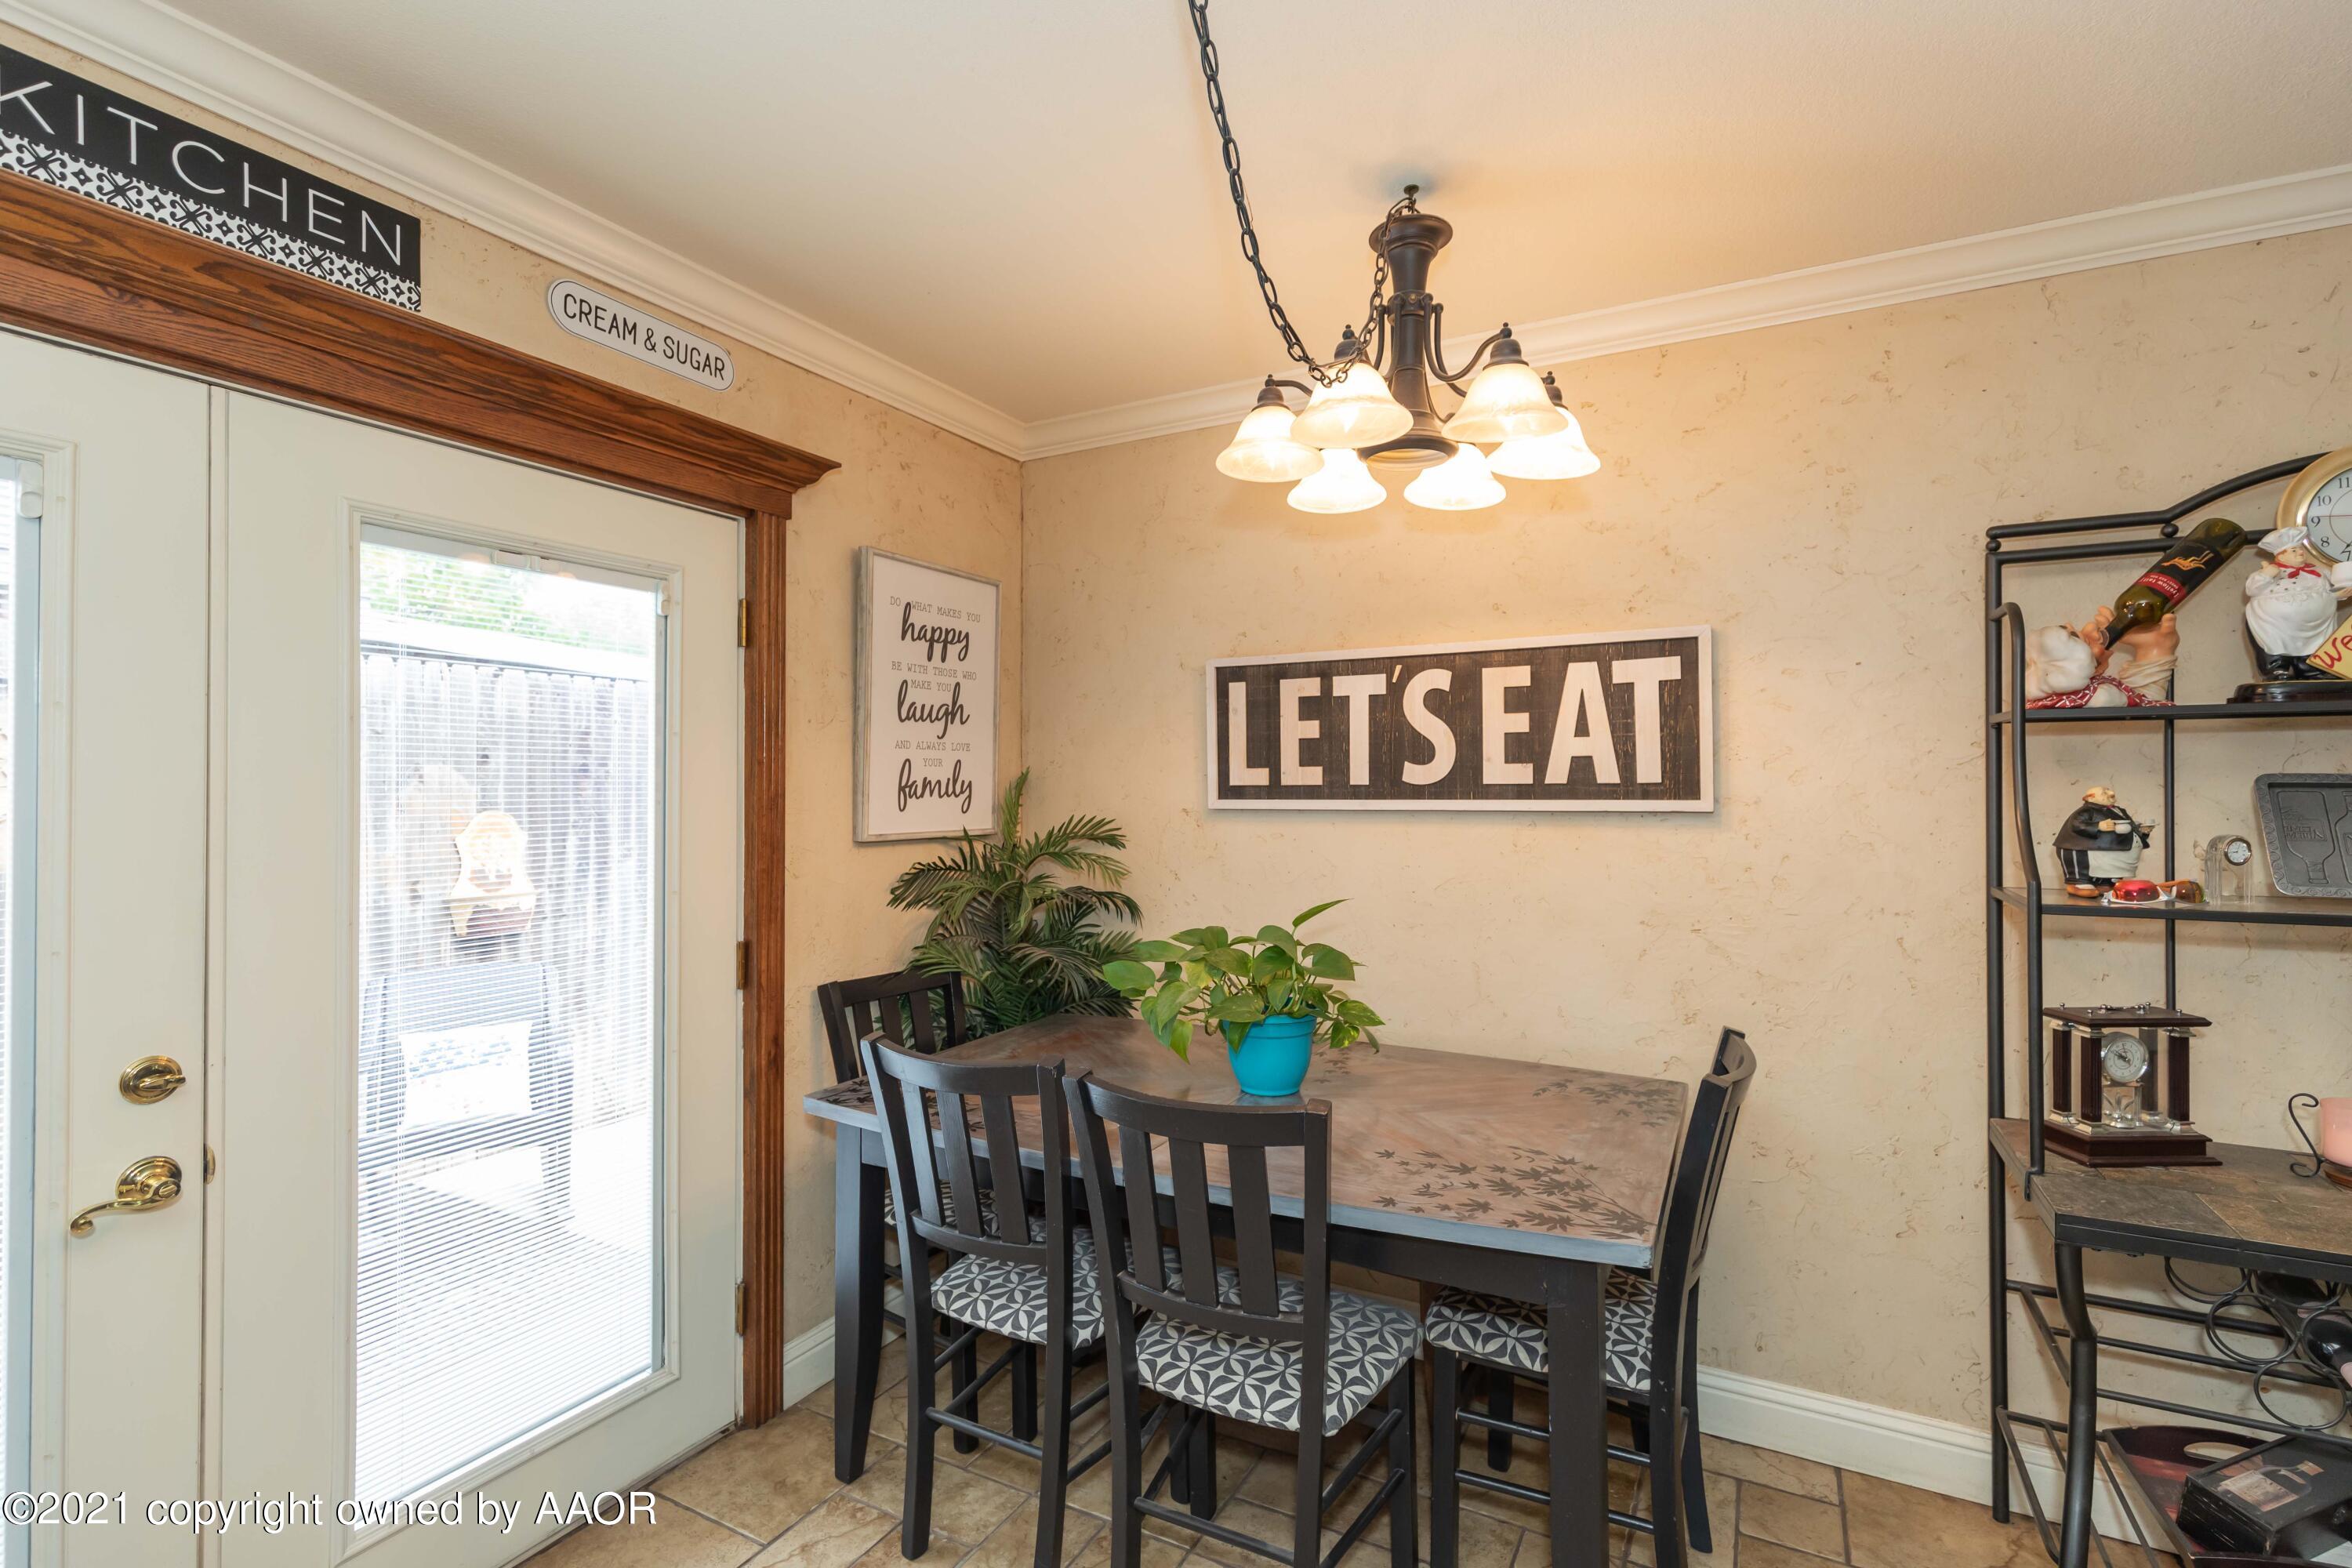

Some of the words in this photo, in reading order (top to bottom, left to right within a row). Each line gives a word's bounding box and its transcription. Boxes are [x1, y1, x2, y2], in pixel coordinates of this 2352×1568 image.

[0, 82, 401, 265] KITCHEN
[564, 293, 637, 345] CREAM
[644, 328, 657, 353] &
[662, 336, 725, 381] SUGAR
[2339, 477, 2350, 488] 11
[2318, 495, 2332, 506] 10
[2310, 516, 2321, 527] 9
[2321, 535, 2330, 547] 8
[890, 596, 901, 605] DO
[911, 601, 933, 613] WHAT
[937, 607, 962, 619] MAKES
[967, 612, 981, 623] YOU
[901, 602, 970, 663] happy
[891, 661, 902, 671] BE
[907, 662, 928, 675] WITH
[932, 666, 958, 678] THOSE
[962, 671, 977, 681] WHO
[910, 679, 932, 691] MAKE
[936, 682, 952, 693] YOU
[897, 679, 971, 739] laugh
[1228, 663, 1457, 786] LET'S
[1482, 655, 1682, 785] EAT
[895, 740, 911, 750] AND
[916, 741, 946, 751] ALWAYS
[951, 742, 971, 752] LOVE
[923, 757, 943, 768] YOUR
[898, 758, 972, 814] family
